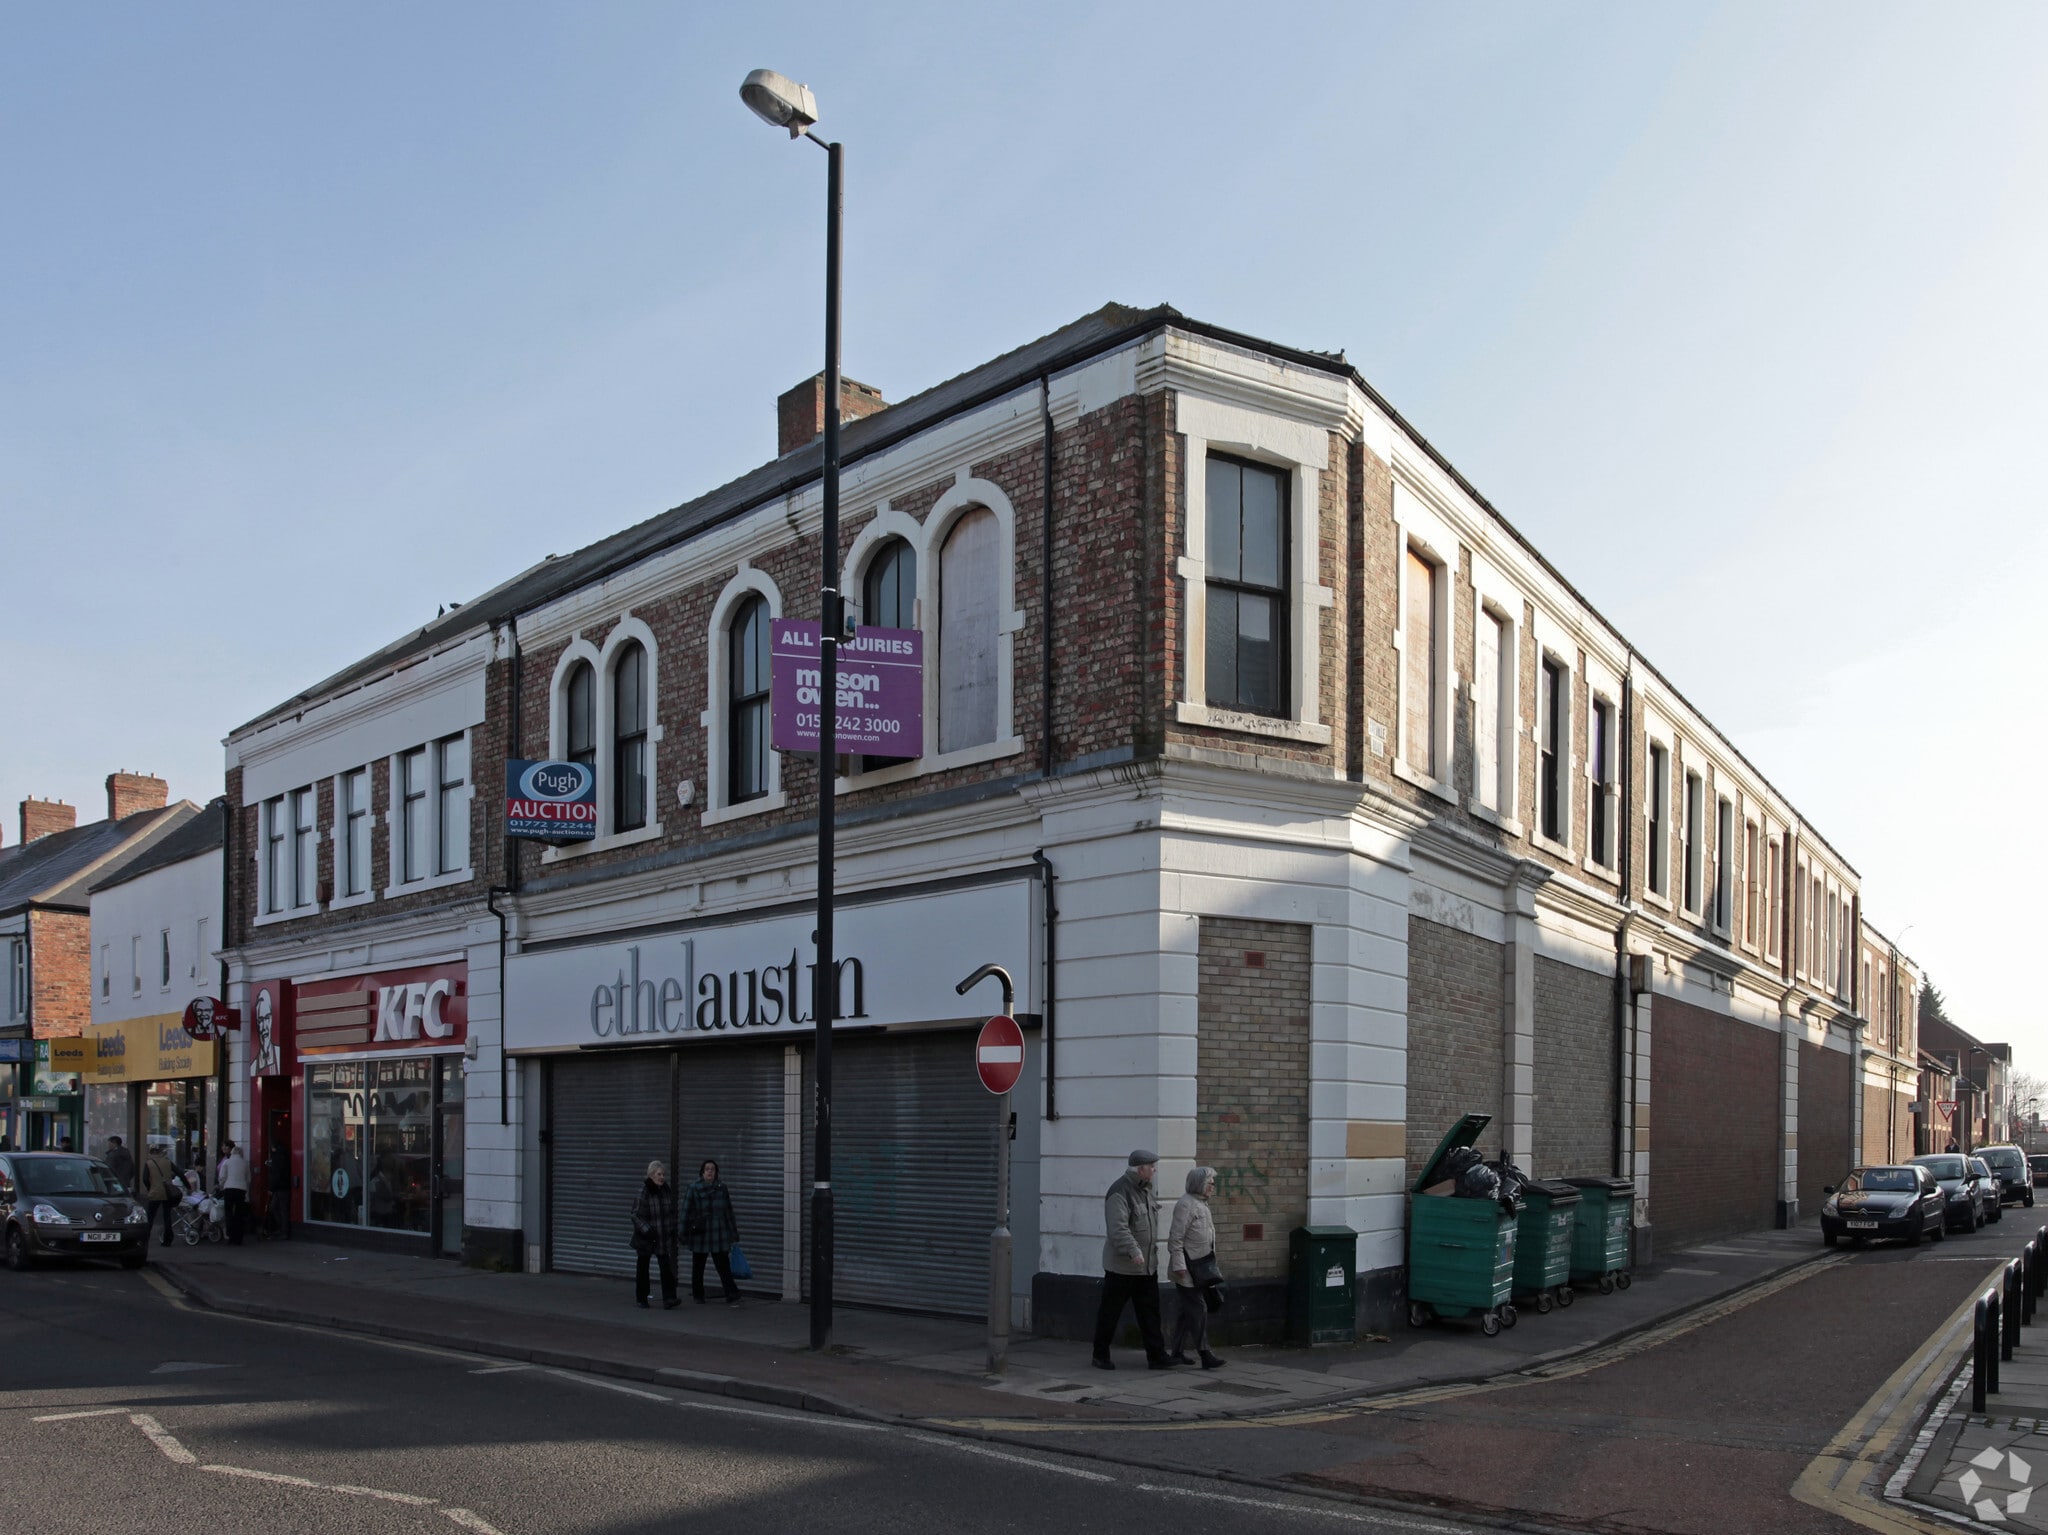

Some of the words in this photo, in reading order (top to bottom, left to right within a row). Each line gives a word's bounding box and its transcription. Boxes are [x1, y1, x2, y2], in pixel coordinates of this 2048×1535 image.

[781, 630, 814, 647] ALL
[819, 637, 914, 655] QUIRIES
[796, 668, 880, 692] mson
[835, 715, 861, 731] 242
[864, 717, 900, 733] 3000
[538, 771, 578, 793] Pugh
[510, 819, 548, 828] 01772
[373, 978, 456, 1043] KFC
[97, 1029, 125, 1057] Leeds
[159, 1023, 192, 1052] Leeds
[54, 1048, 84, 1057] Leeds
[159, 1057, 176, 1073] Building
[176, 1055, 192, 1071] Society
